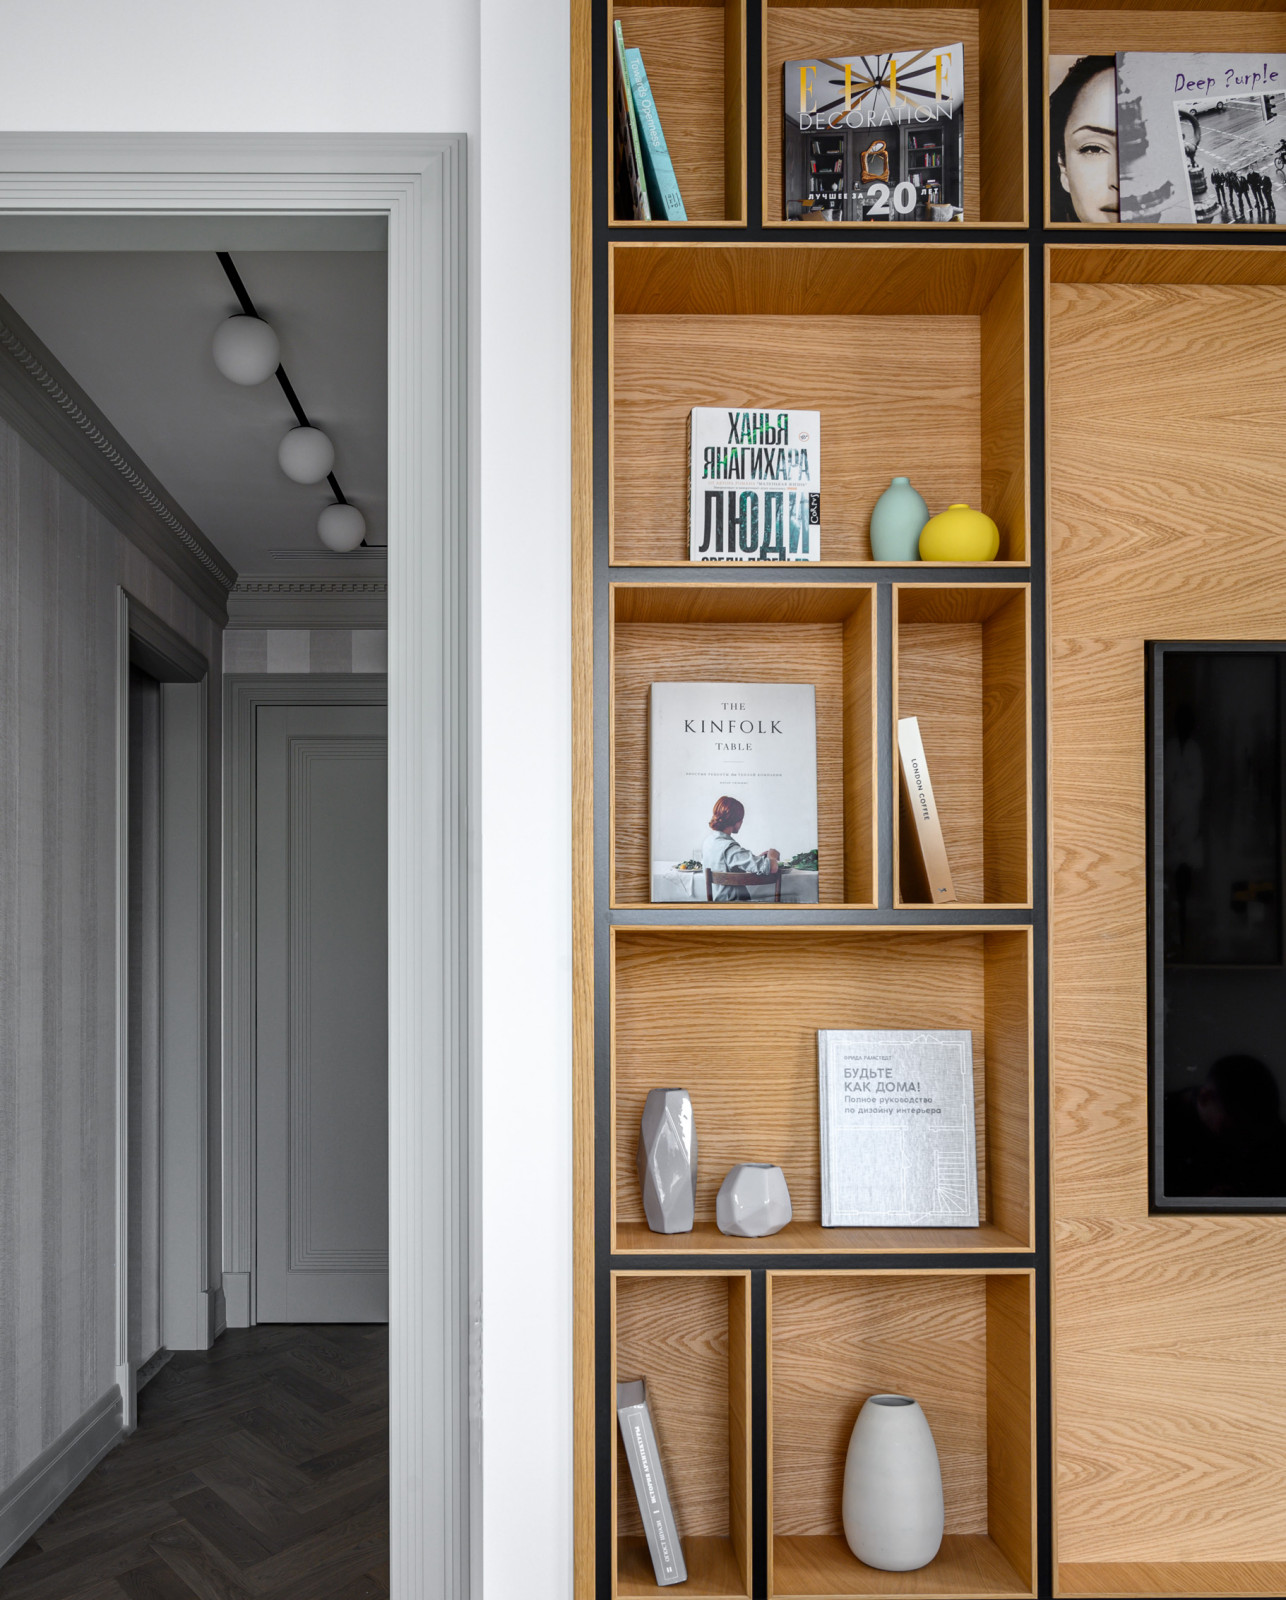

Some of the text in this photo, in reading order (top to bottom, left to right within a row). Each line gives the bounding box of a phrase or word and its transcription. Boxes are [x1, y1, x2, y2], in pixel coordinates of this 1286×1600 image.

[797, 53, 953, 113] ELLE
[1173, 73, 1215, 95] Deep
[631, 58, 648, 97] Towards
[641, 99, 660, 147] Openness
[800, 103, 953, 131] DECORATION
[866, 181, 917, 216] 20
[921, 188, 939, 196] ЛЕТ
[728, 412, 788, 445] ХАНЬЯ
[702, 447, 810, 481] ЯНАГИХАРА
[699, 491, 809, 560] ЛЮДИ
[684, 719, 783, 734] KINFOLK
[715, 743, 753, 751] TABLE
[911, 758, 930, 820] LONDON COFFEE
[844, 1068, 893, 1079] БУДЬТЕ
[844, 1082, 921, 1093] КАК ДОМА!
[858, 1106, 893, 1115] дизайну
